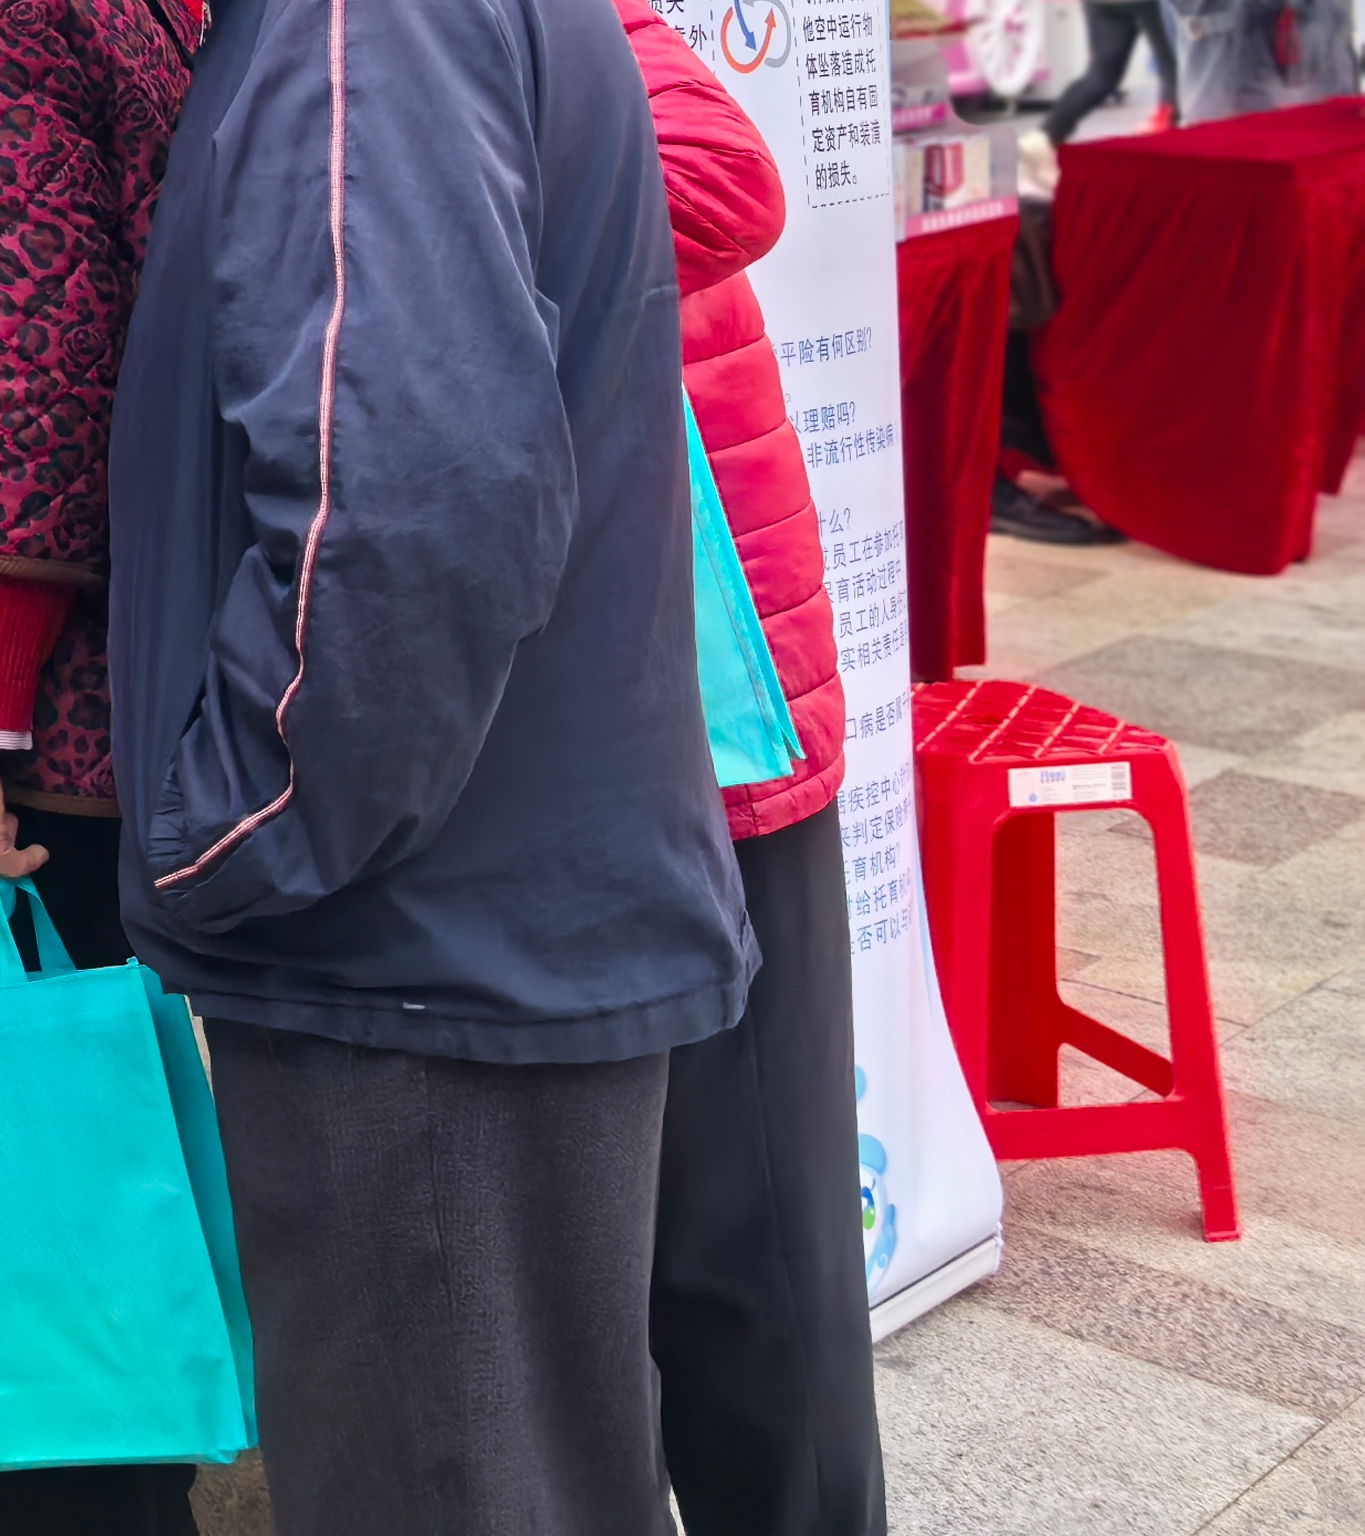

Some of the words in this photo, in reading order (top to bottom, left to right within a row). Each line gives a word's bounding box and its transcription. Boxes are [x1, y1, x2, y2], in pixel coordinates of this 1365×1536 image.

[803, 13, 873, 43] 他空中运行物
[806, 49, 876, 79] 体坠落造成托
[809, 85, 878, 116] 育机构自有固
[815, 160, 857, 190] 的损失。
[773, 326, 871, 367] 平险有何区别?
[807, 421, 897, 468] 非流行性传染病
[844, 842, 900, 885] 育机构?
